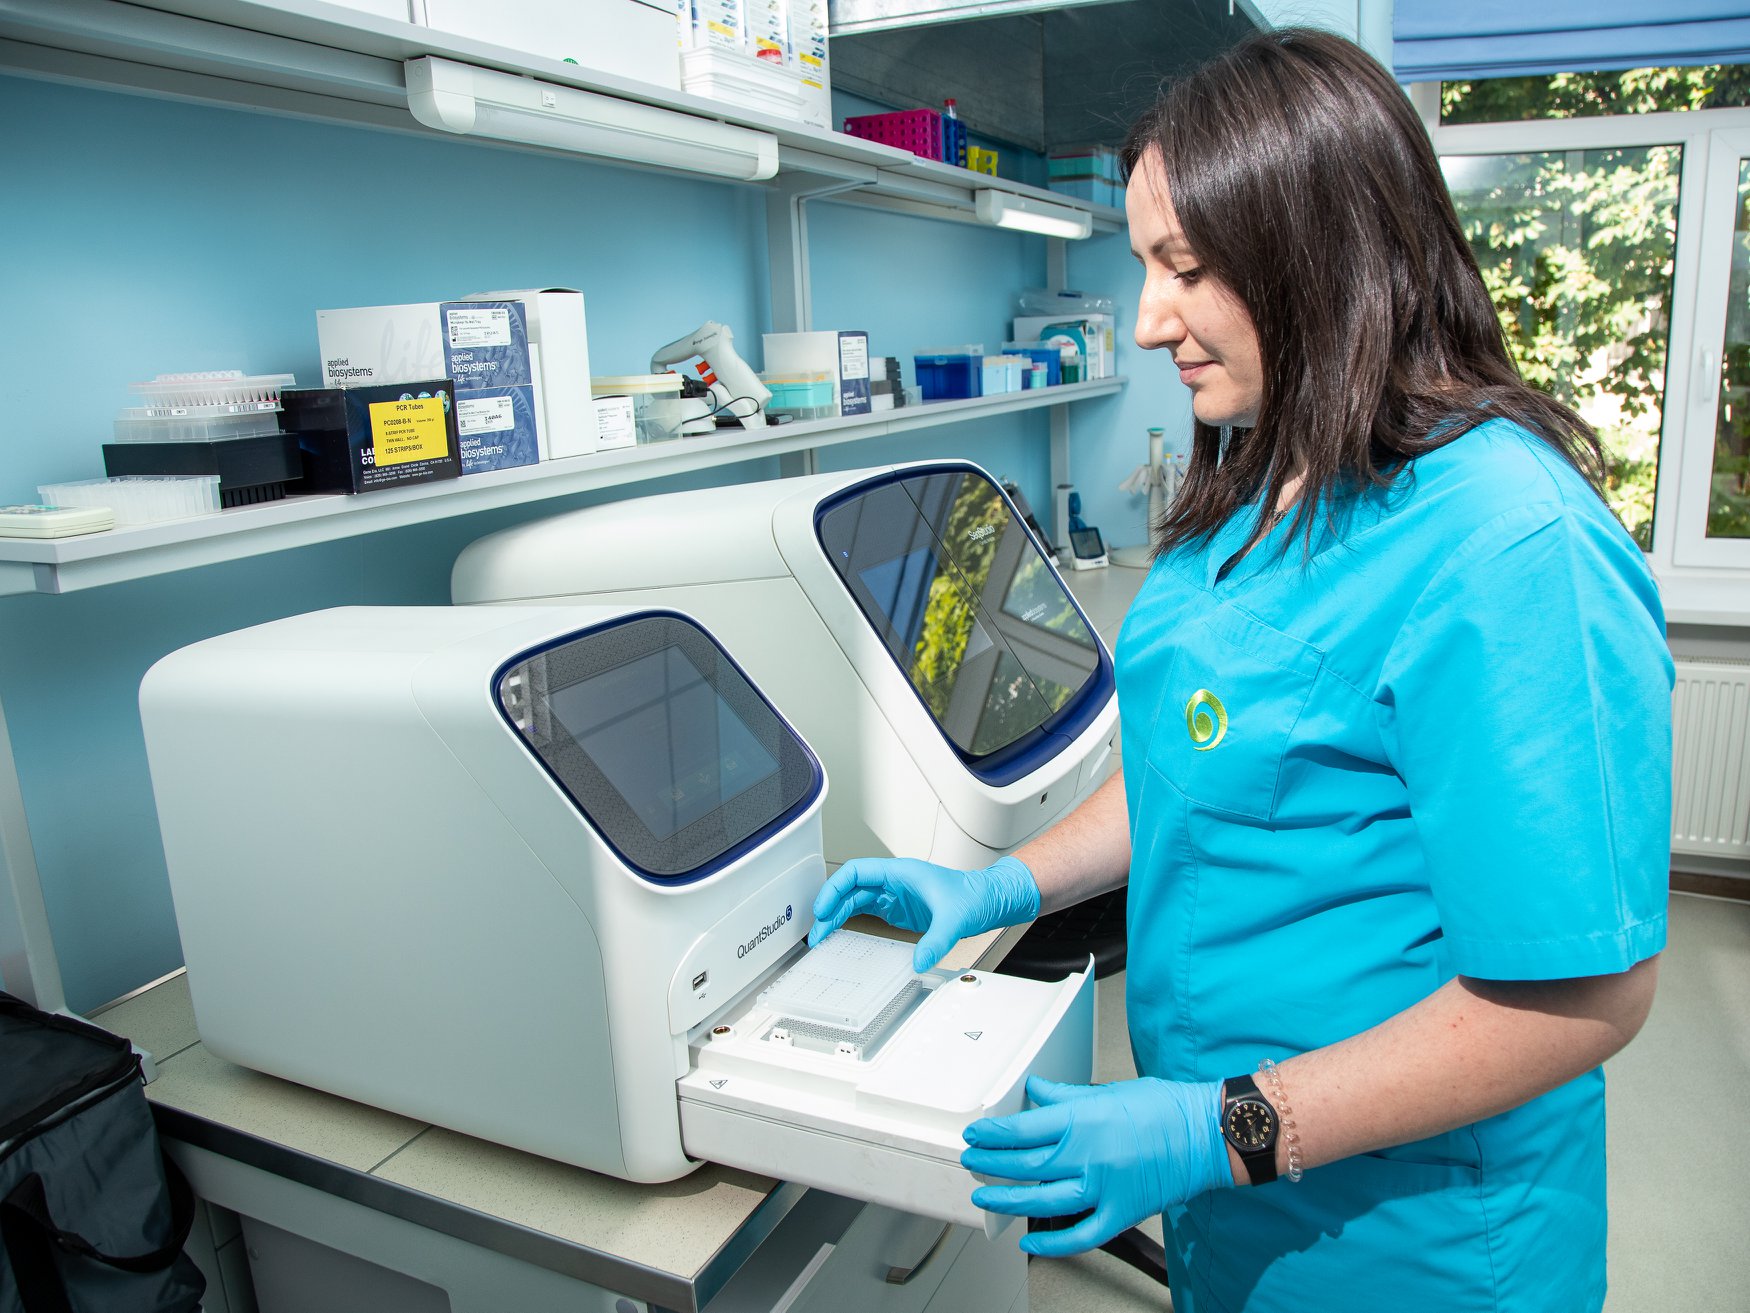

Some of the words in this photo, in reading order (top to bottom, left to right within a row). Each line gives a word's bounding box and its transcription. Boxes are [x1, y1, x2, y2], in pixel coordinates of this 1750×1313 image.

[327, 358, 349, 370] applied
[452, 352, 474, 364] applied
[327, 366, 373, 380] biosystems
[451, 361, 496, 375] biosystems
[409, 403, 424, 411] Tubes
[385, 447, 394, 455] 125
[394, 444, 424, 454] STRIPS/BOX
[362, 456, 376, 465] CO
[737, 915, 785, 959] QuantStudio
[786, 906, 792, 920] 5
